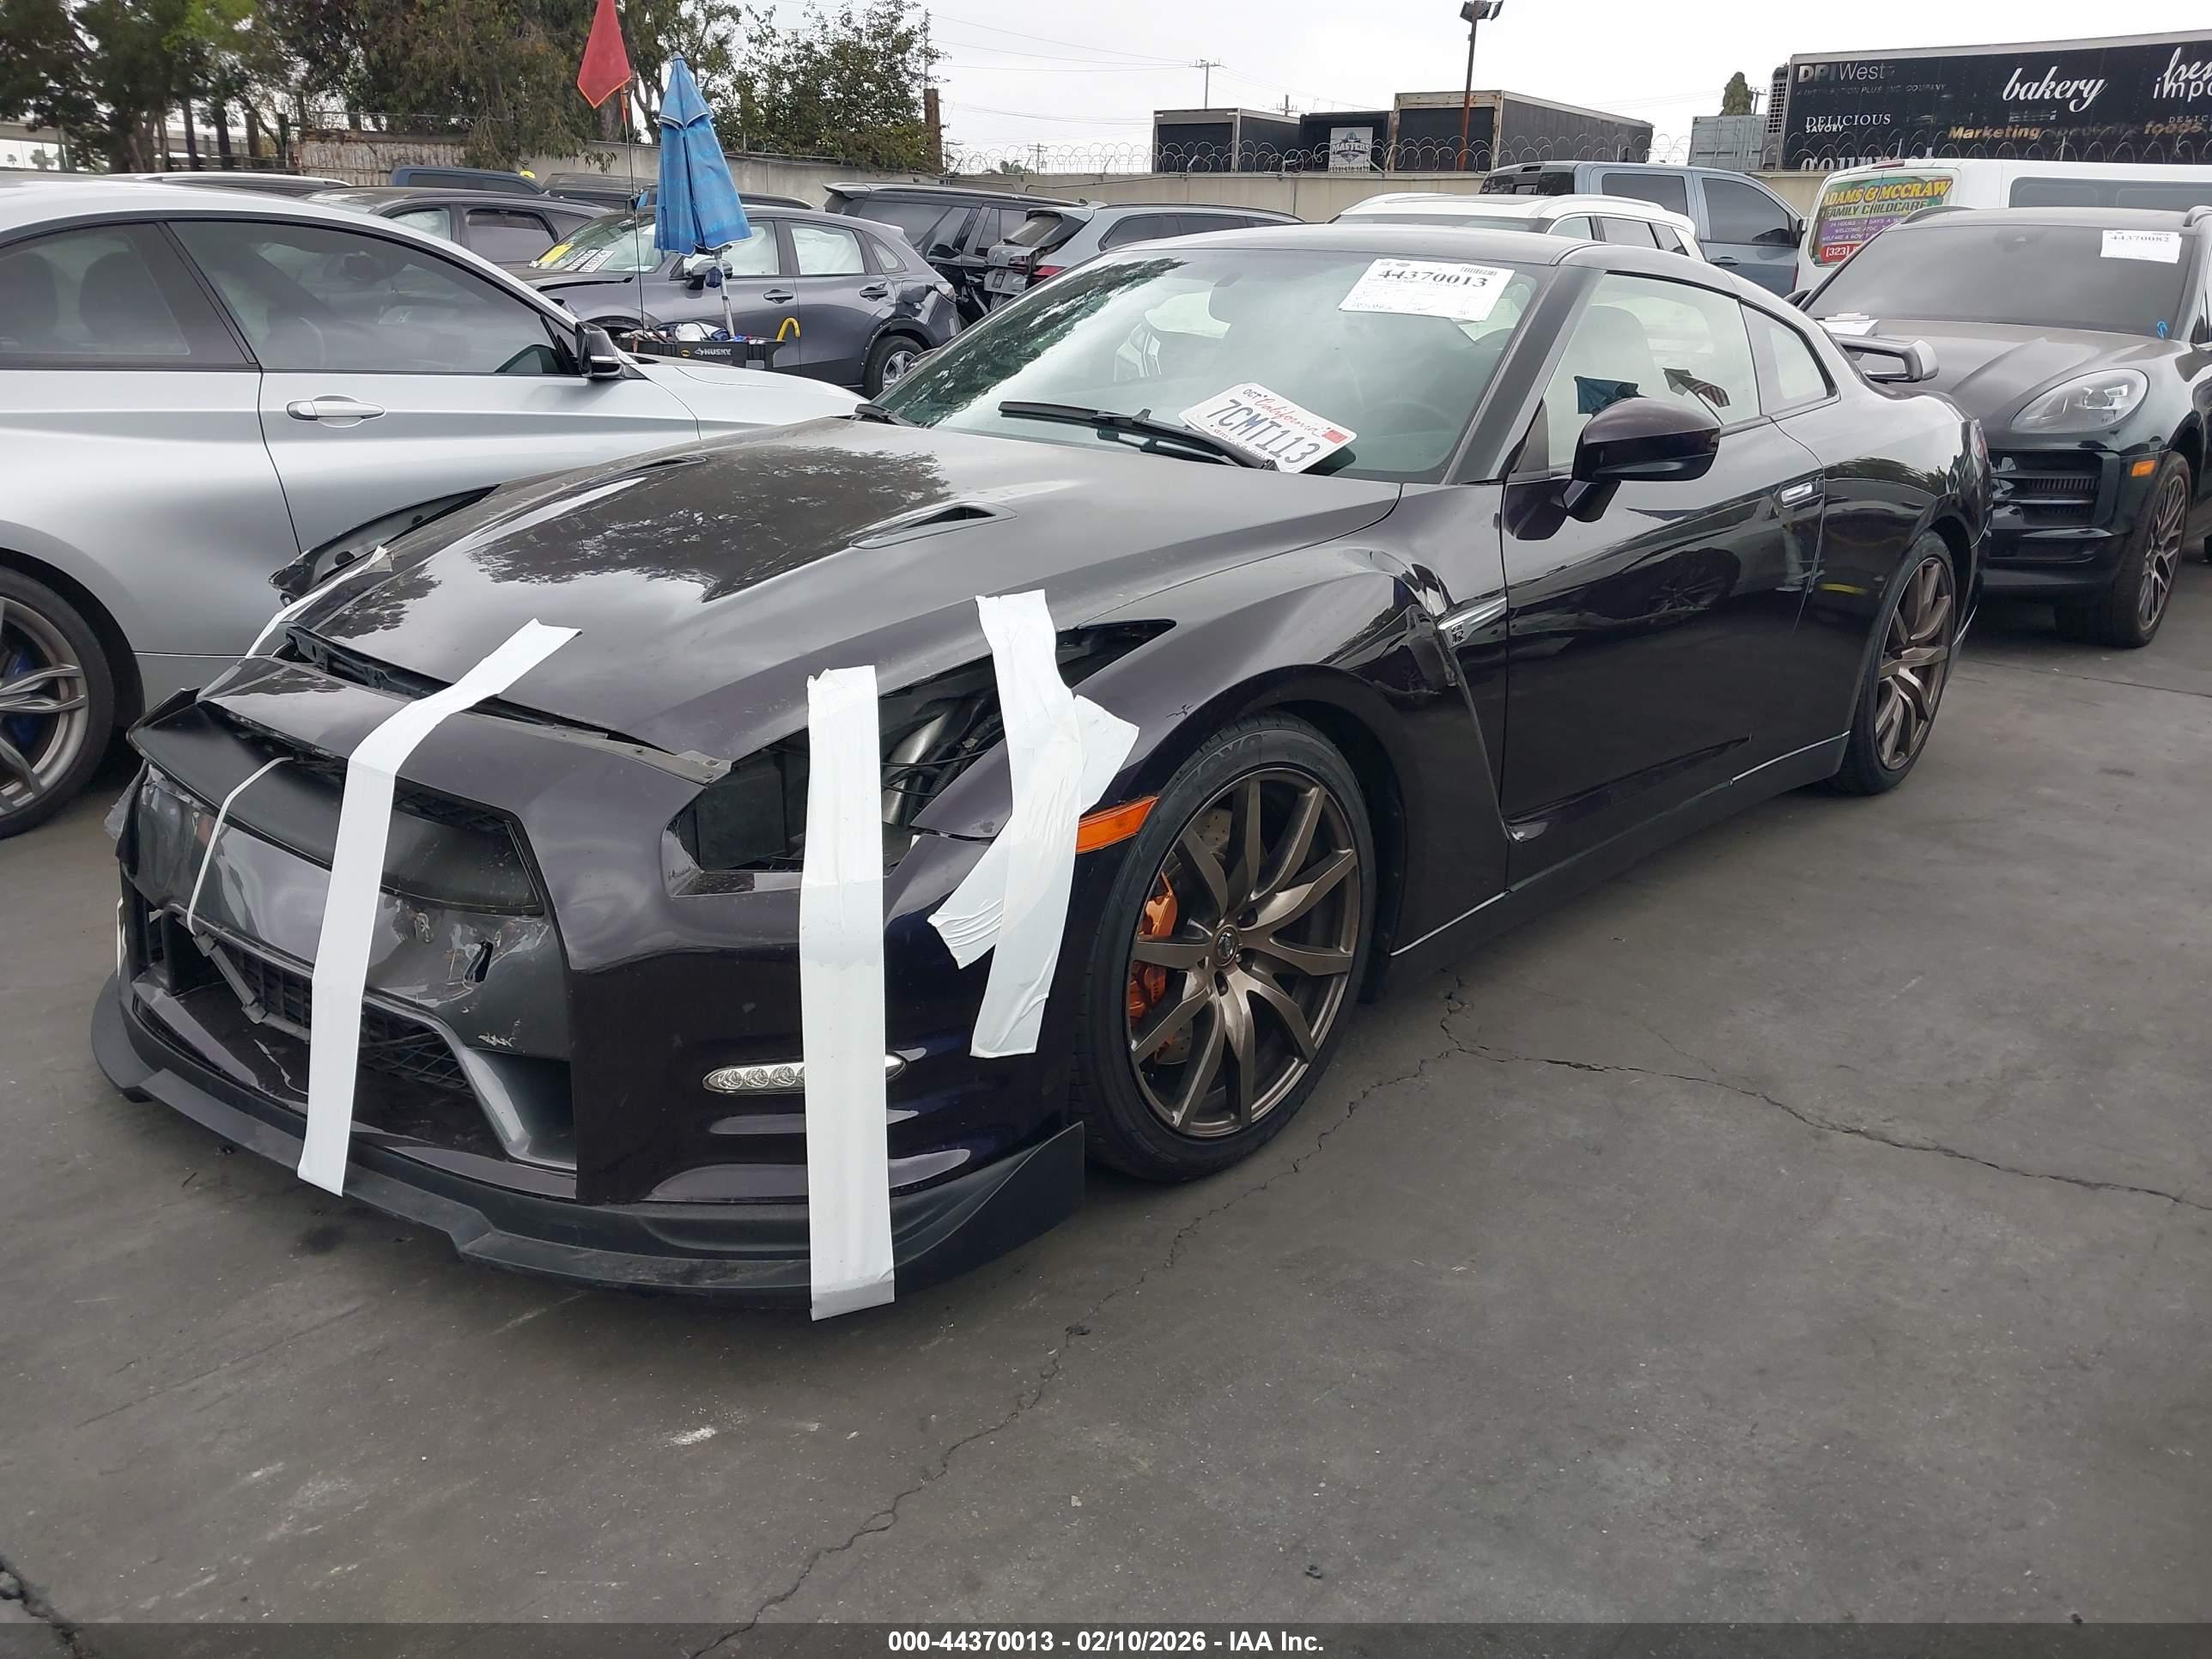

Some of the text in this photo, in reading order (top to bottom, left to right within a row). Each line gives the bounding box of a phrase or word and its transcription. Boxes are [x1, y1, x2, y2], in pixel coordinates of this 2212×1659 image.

[1838, 62, 1885, 82] West
[2002, 66, 2108, 112] bakery
[1806, 114, 1891, 126] DELICIOUS
[2169, 114, 2212, 124] DELIC
[1805, 124, 1844, 133] SAVORY
[1948, 125, 2041, 140] Marketing
[1332, 142, 1370, 152] MASTERS
[1823, 180, 1952, 205] ADAMS & MCCRAW
[1826, 201, 1928, 218] FAMILY CHILDCARE
[1378, 270, 1488, 287] 44370013
[704, 348, 732, 356] HUSKY
[1243, 389, 1261, 398] OCT
[1255, 398, 1320, 437] California
[1206, 398, 1321, 464] 7CMT113
